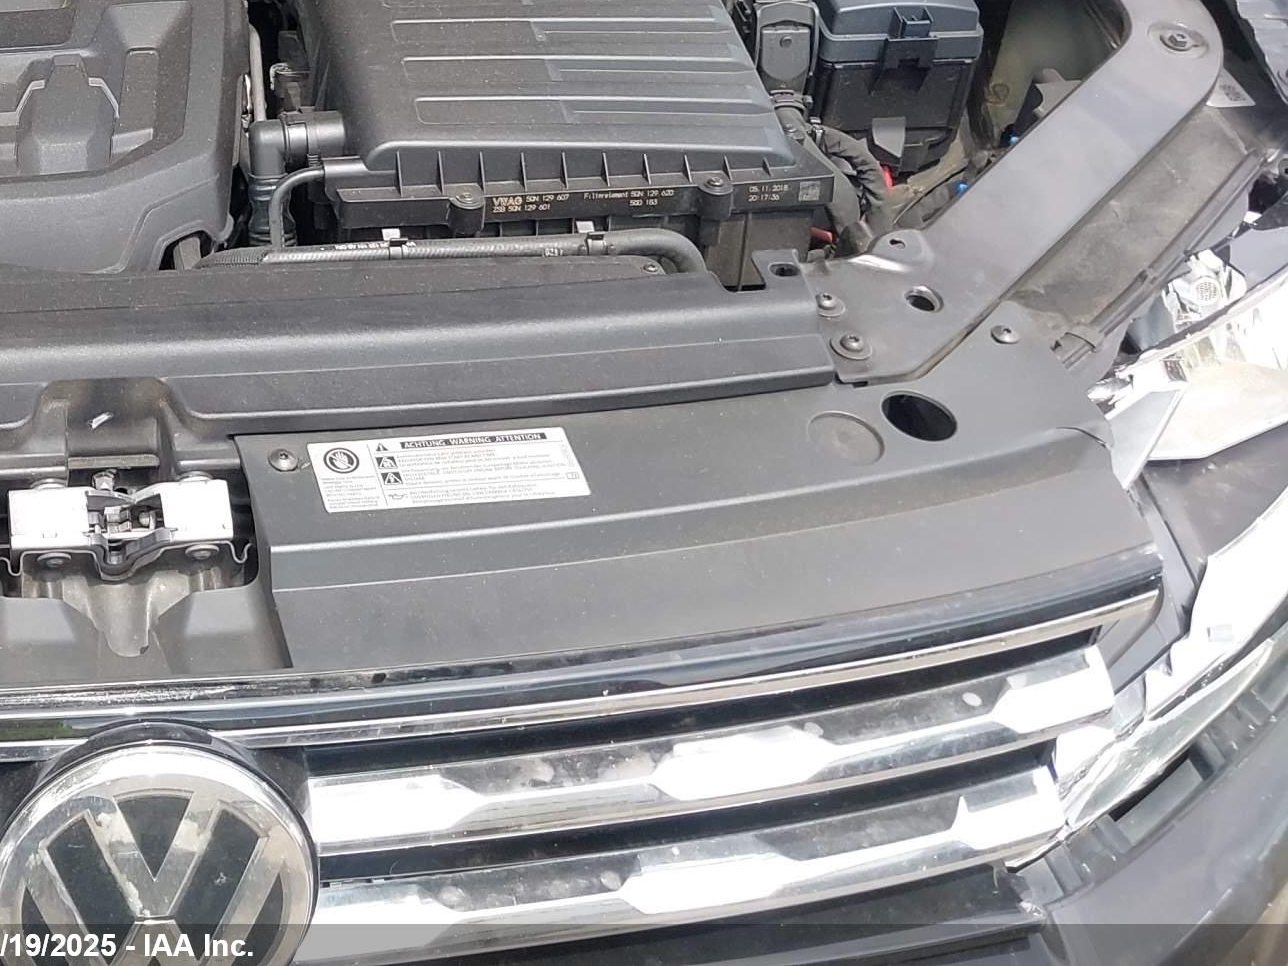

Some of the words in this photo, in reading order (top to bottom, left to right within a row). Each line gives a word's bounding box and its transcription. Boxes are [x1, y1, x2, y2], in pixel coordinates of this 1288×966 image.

[542, 194, 554, 202] 129
[557, 193, 570, 201] 607
[647, 189, 659, 197] 129
[524, 204, 536, 212] 129
[538, 203, 551, 211] 601
[404, 439, 446, 448] ACHTUNG
[449, 436, 492, 445] WARNING
[494, 433, 541, 442] ATTENTION
